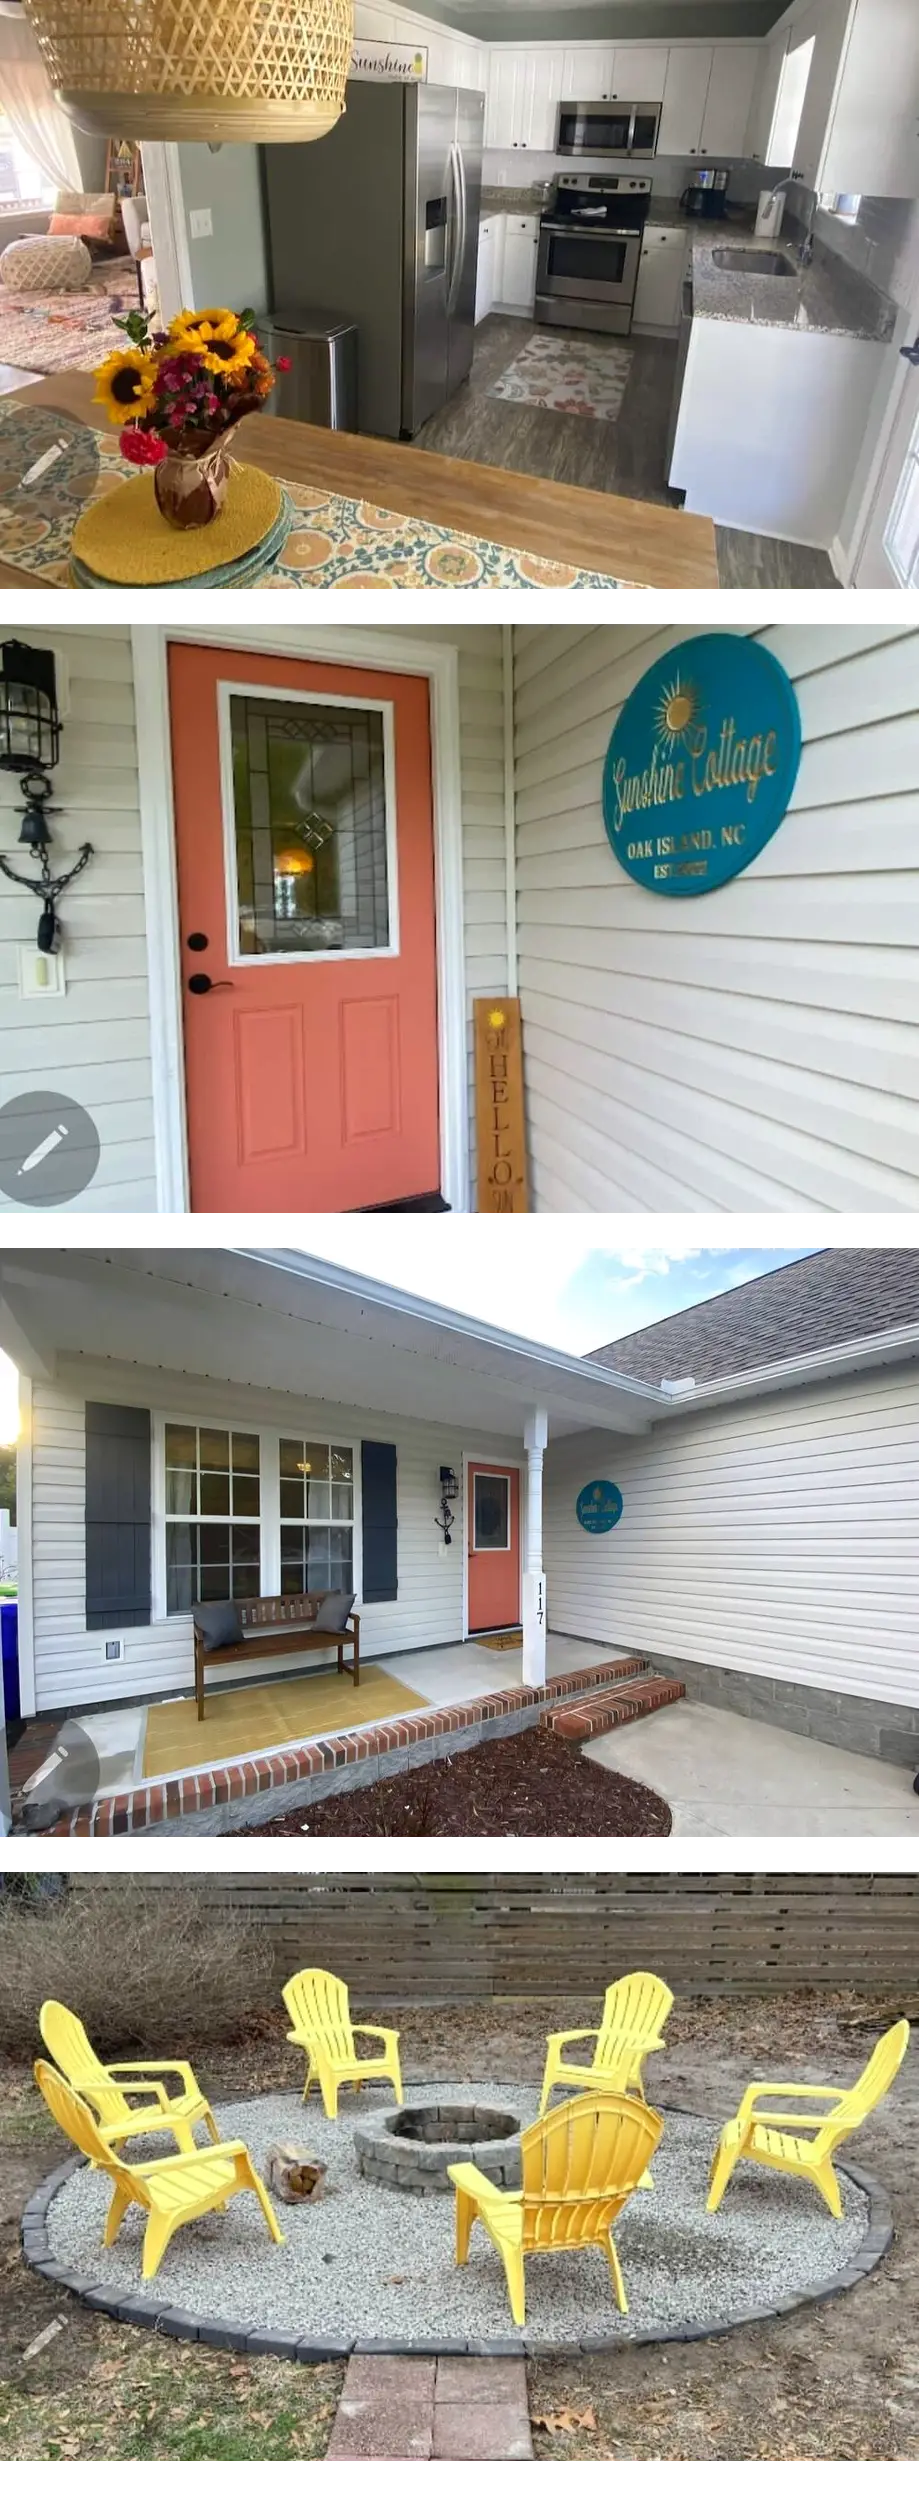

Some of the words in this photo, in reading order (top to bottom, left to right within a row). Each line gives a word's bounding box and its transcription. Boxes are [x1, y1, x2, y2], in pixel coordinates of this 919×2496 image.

[352, 50, 413, 73] Sunshine
[613, 744, 683, 832] Sunshine
[683, 717, 775, 803] Cottage
[627, 840, 653, 859] OAK
[721, 824, 745, 846] NC
[490, 1055, 512, 1185] HELLO
[536, 1581, 544, 1625] 117
